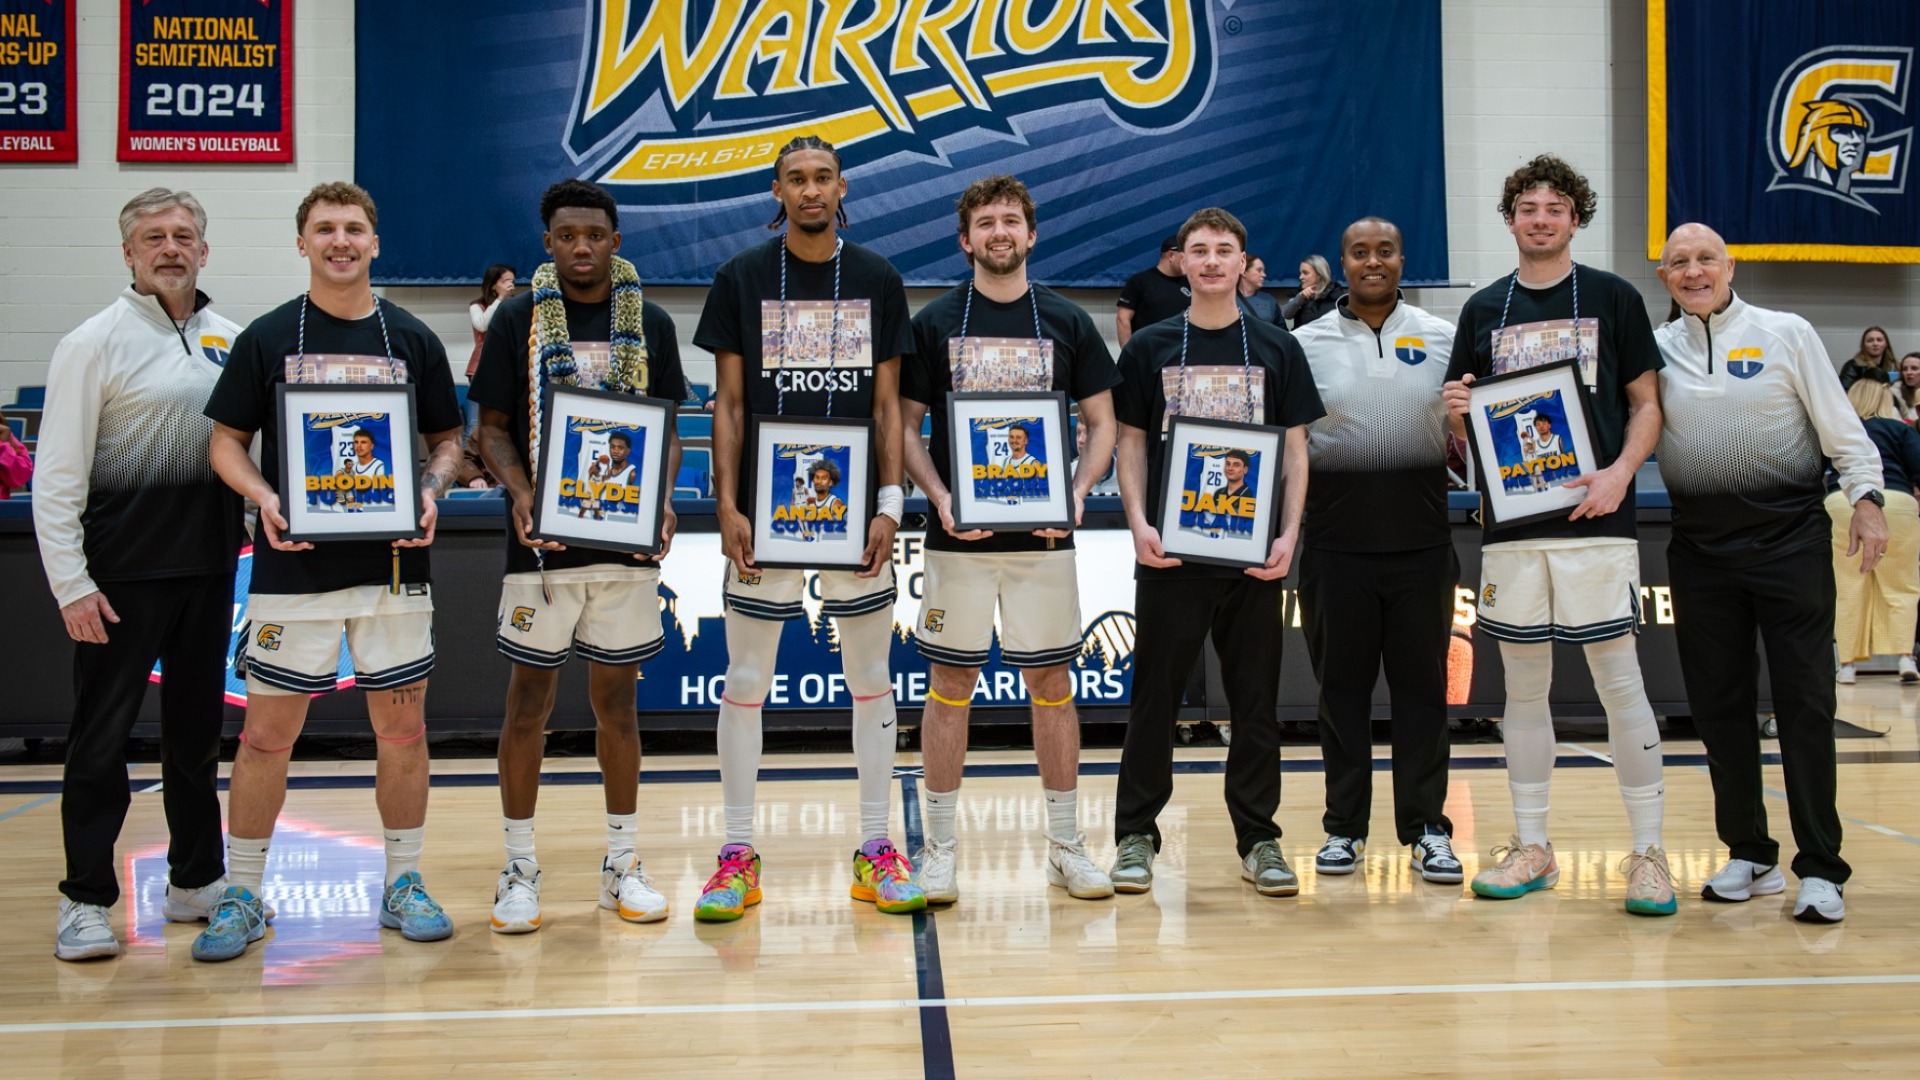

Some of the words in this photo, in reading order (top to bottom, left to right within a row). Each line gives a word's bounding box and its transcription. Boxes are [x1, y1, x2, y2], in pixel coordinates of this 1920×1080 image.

[153, 16, 259, 40] NATIONAL
[135, 43, 277, 67] SEMIFINALIST
[146, 83, 265, 117] 2024
[130, 137, 196, 151] WOMEN'S
[199, 137, 281, 151] VOLLEYBALL
[339, 441, 356, 457] 23
[994, 441, 1009, 456] 24
[972, 463, 1048, 479] BRADY
[1498, 451, 1576, 480] PAYTON
[305, 474, 395, 491] BRODIN
[1206, 471, 1222, 487] 26
[559, 477, 640, 504] CLYDE
[772, 504, 847, 521] ANJAY
[1180, 489, 1257, 518] JAKE
[681, 674, 789, 705] HOE
[800, 673, 845, 703] OF
